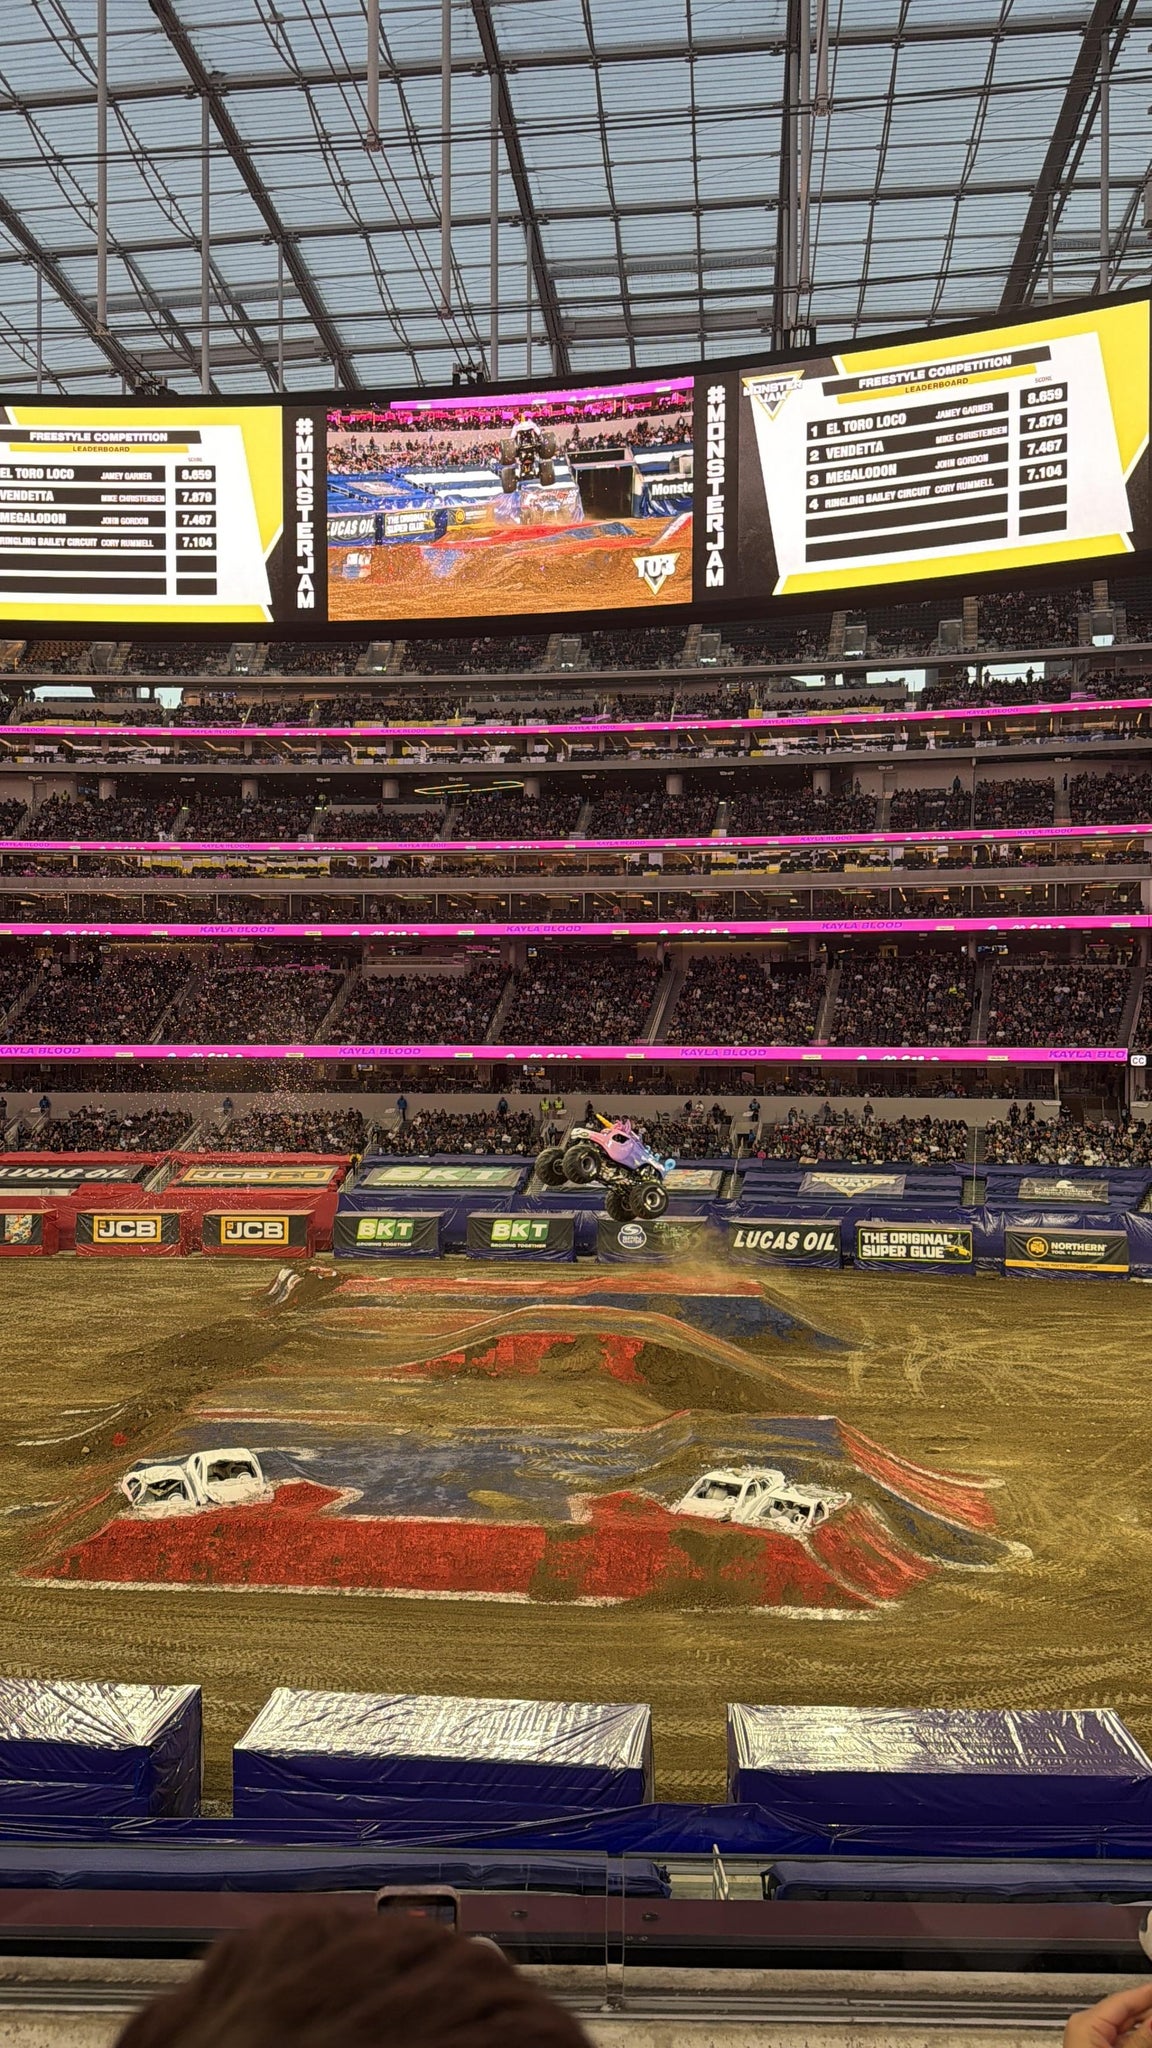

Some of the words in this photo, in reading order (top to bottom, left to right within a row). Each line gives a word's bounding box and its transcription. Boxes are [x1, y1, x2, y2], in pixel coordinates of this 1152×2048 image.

[859, 369, 926, 389] FREESTYLE
[928, 355, 1012, 378] COMPETITION
[743, 379, 803, 397] MONSTER
[905, 377, 969, 393] LEADERBOARD
[761, 391, 786, 403] JAM
[1027, 388, 1063, 404] 8.659
[811, 425, 818, 437] 1
[826, 423, 841, 435] EL
[843, 418, 873, 433] TORO
[876, 413, 907, 428] LOCO
[935, 408, 961, 420] JAMEY
[29, 431, 91, 442] FREESTYLE
[93, 432, 168, 442] COMPETITION
[809, 450, 819, 462] 2
[826, 440, 884, 460] VENDETTA
[935, 434, 954, 444] MIKE
[0, 467, 13, 479] EL
[15, 468, 44, 479] TORO
[46, 468, 75, 480] LOCO
[181, 469, 212, 480] 8.659
[809, 474, 819, 486] 3
[826, 463, 897, 484] MEGALODON
[935, 459, 956, 469] JOHN
[1027, 464, 1062, 481] 7.104
[706, 385, 726, 588] #MONSTERJAM
[809, 498, 819, 510] 4
[866, 491, 896, 503] BAILEY
[897, 486, 931, 499] CIRCUIT
[934, 483, 955, 494] CORY
[956, 478, 994, 491] RUMMELL
[0, 489, 55, 502] VENDETTA
[0, 512, 67, 524] MEGALODON
[296, 418, 315, 609] #MONSTERJAM
[359, 519, 376, 535] OIL
[66, 538, 98, 547] CIRCUIT
[101, 539, 120, 547] CORY
[182, 536, 213, 548] 7.104
[338, 1047, 375, 1055] KAYLA
[379, 1047, 421, 1055] BLOOD
[723, 1048, 767, 1056] BLOOD
[1048, 1050, 1092, 1058] KAYLA
[1132, 1057, 1145, 1065] CC
[84, 1168, 129, 1178] OIL
[192, 1171, 270, 1180] JCB
[380, 1168, 506, 1180] BKT
[99, 1221, 156, 1238] JCB
[226, 1222, 284, 1239] JCB
[359, 1221, 414, 1238] BKT
[494, 1222, 549, 1239] BKT
[733, 1230, 800, 1250] LUCAS
[862, 1232, 888, 1244] THE
[890, 1232, 952, 1245] ORIGINAL
[862, 1245, 907, 1257] SUPER
[910, 1245, 945, 1258] GLUE
[1051, 1242, 1106, 1252] NORTHERN
